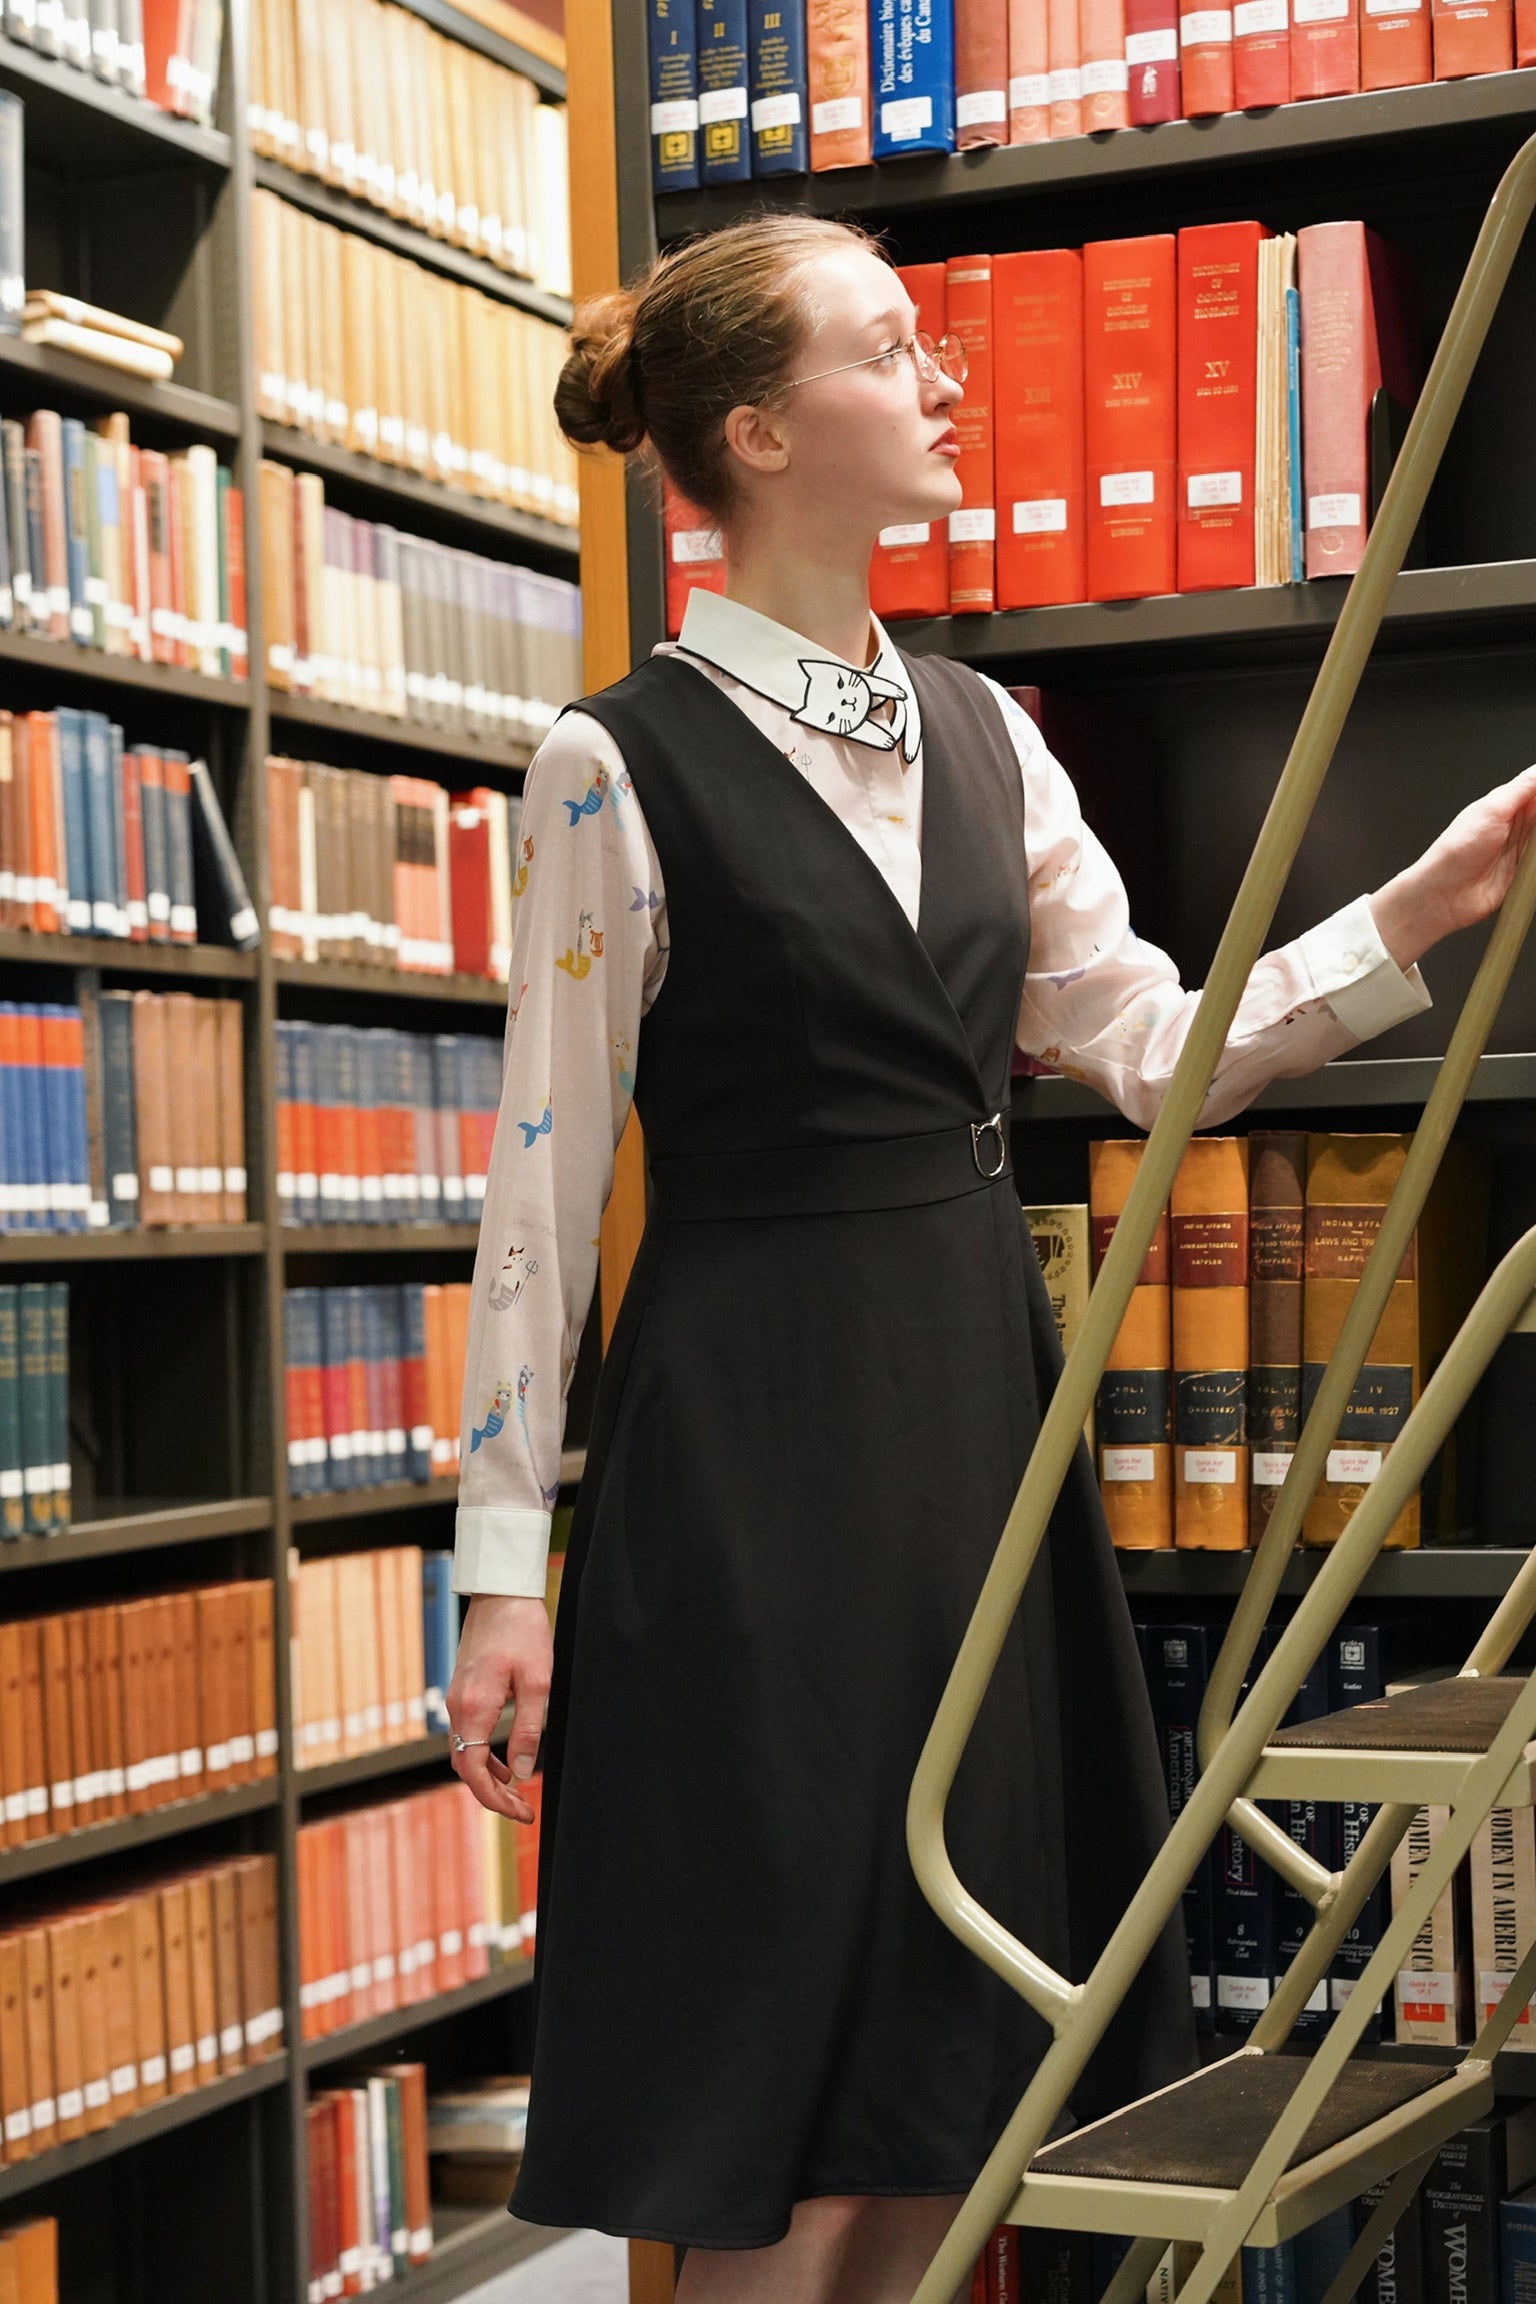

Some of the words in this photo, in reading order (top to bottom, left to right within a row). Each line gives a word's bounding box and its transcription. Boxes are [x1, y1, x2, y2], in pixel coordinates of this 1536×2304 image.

[764, 12, 780, 29] III
[670, 30, 678, 45] I
[714, 22, 725, 38] II
[915, 28, 932, 44] du
[879, 22, 896, 93] Dictionnaire
[897, 62, 914, 83] des
[1205, 360, 1230, 378] XV
[1112, 373, 1142, 390] XIV
[1358, 1220, 1380, 1228] AFFA
[1315, 1237, 1339, 1246] LAWS
[1341, 1237, 1359, 1246] AND
[1052, 1294, 1066, 1319] The
[1369, 1386, 1383, 1394] IV
[1379, 1407, 1399, 1416] 1927
[1168, 1729, 1184, 1811] American
[1184, 1730, 1194, 1800] DICTIONAR
[1305, 1806, 1316, 1823] OF
[1359, 1807, 1369, 1824] OF
[1343, 1819, 1360, 1866] Histo
[1228, 1833, 1245, 1883] story
[1492, 1873, 1515, 1891] IN
[1296, 1927, 1304, 1937] 9
[1347, 1928, 1360, 1940] 10
[1493, 1896, 1517, 1973] AMERICA
